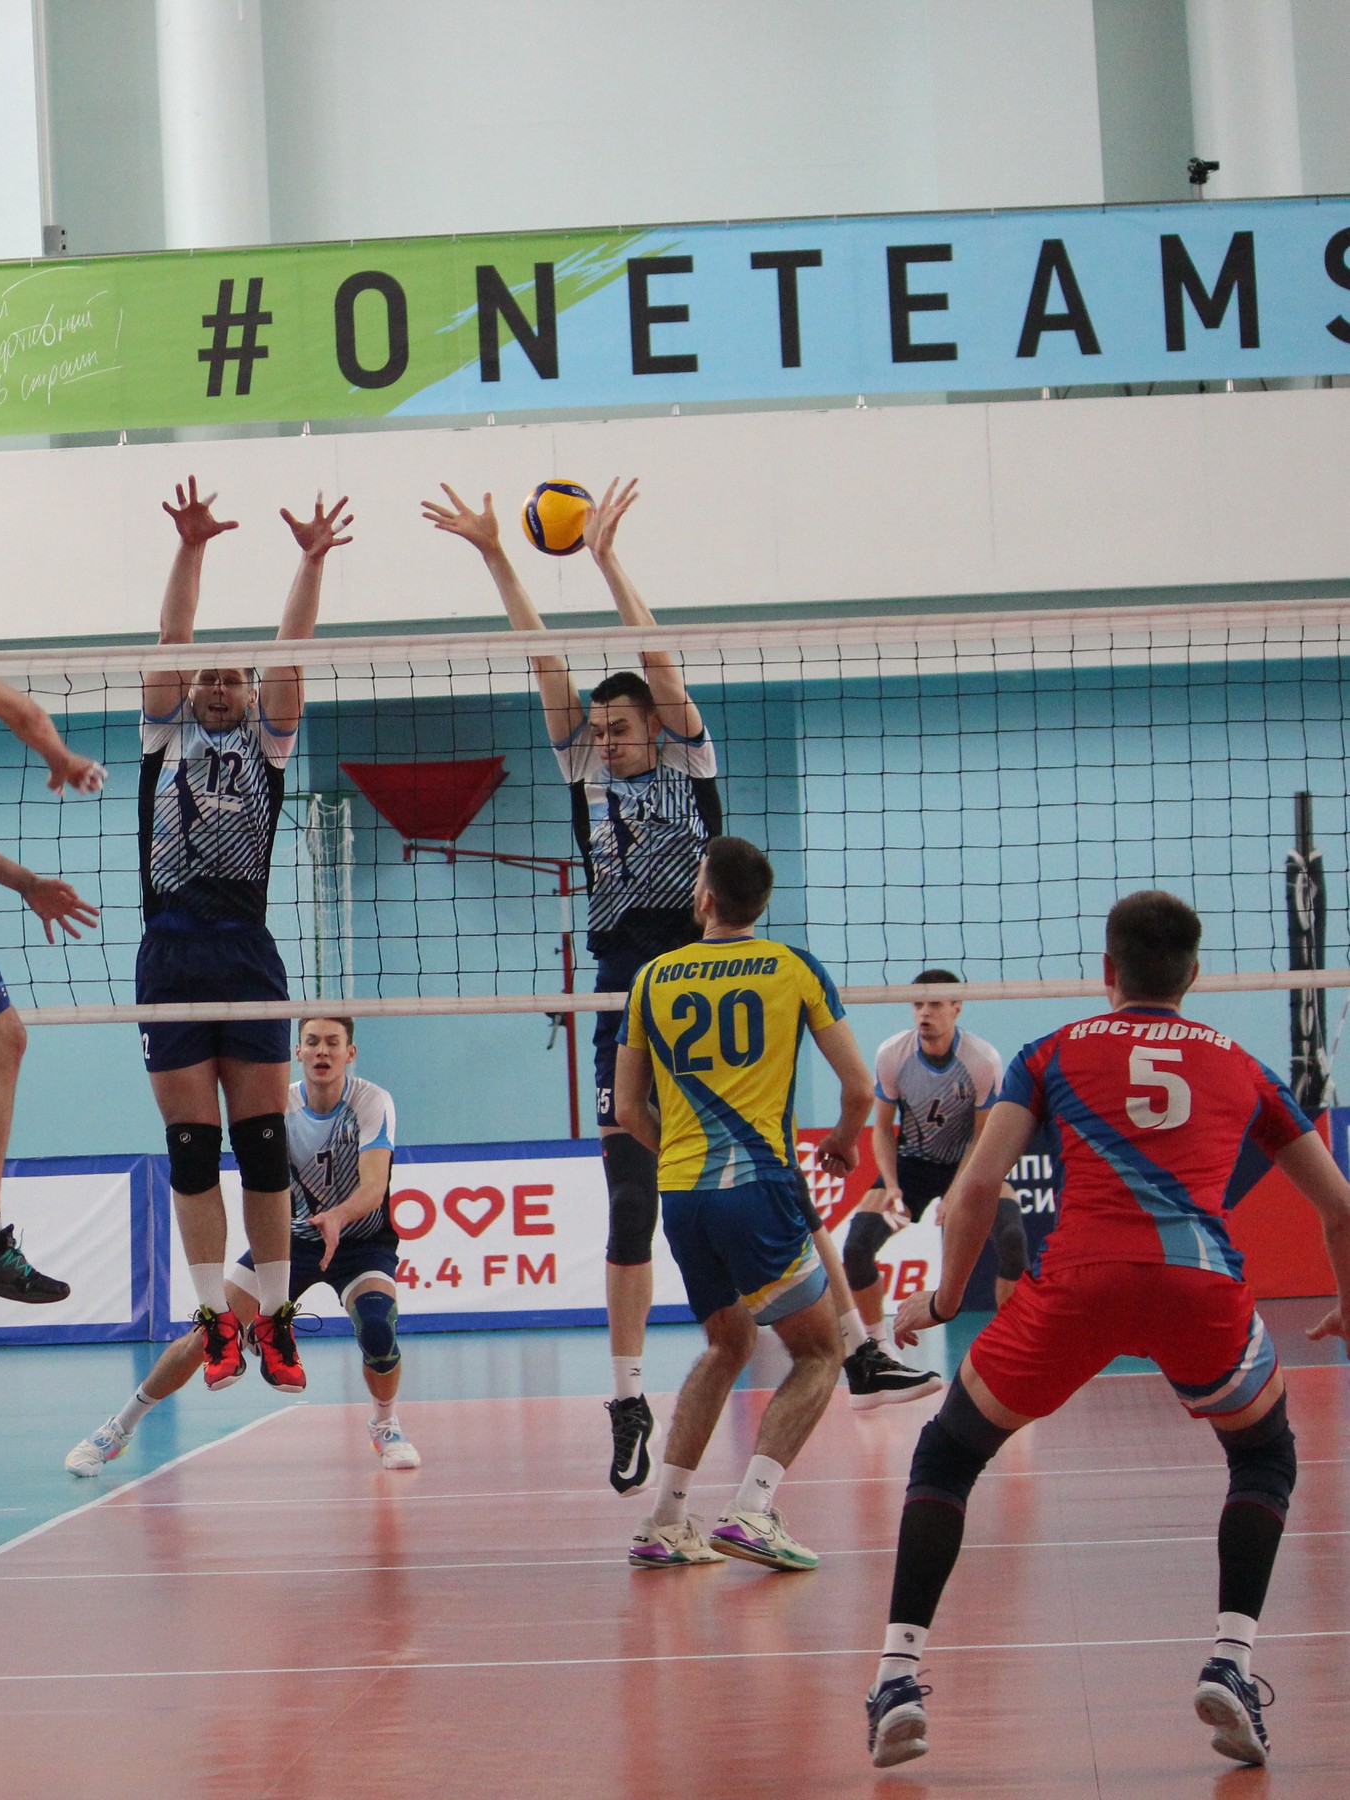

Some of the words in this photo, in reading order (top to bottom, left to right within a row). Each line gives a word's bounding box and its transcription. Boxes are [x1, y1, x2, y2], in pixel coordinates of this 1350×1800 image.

[204, 746, 246, 797] 12
[671, 988, 765, 1076] 20
[1125, 1045, 1192, 1130] 5
[926, 1098, 946, 1129] 4
[314, 1147, 335, 1189] 7
[484, 1253, 556, 1287] FM
